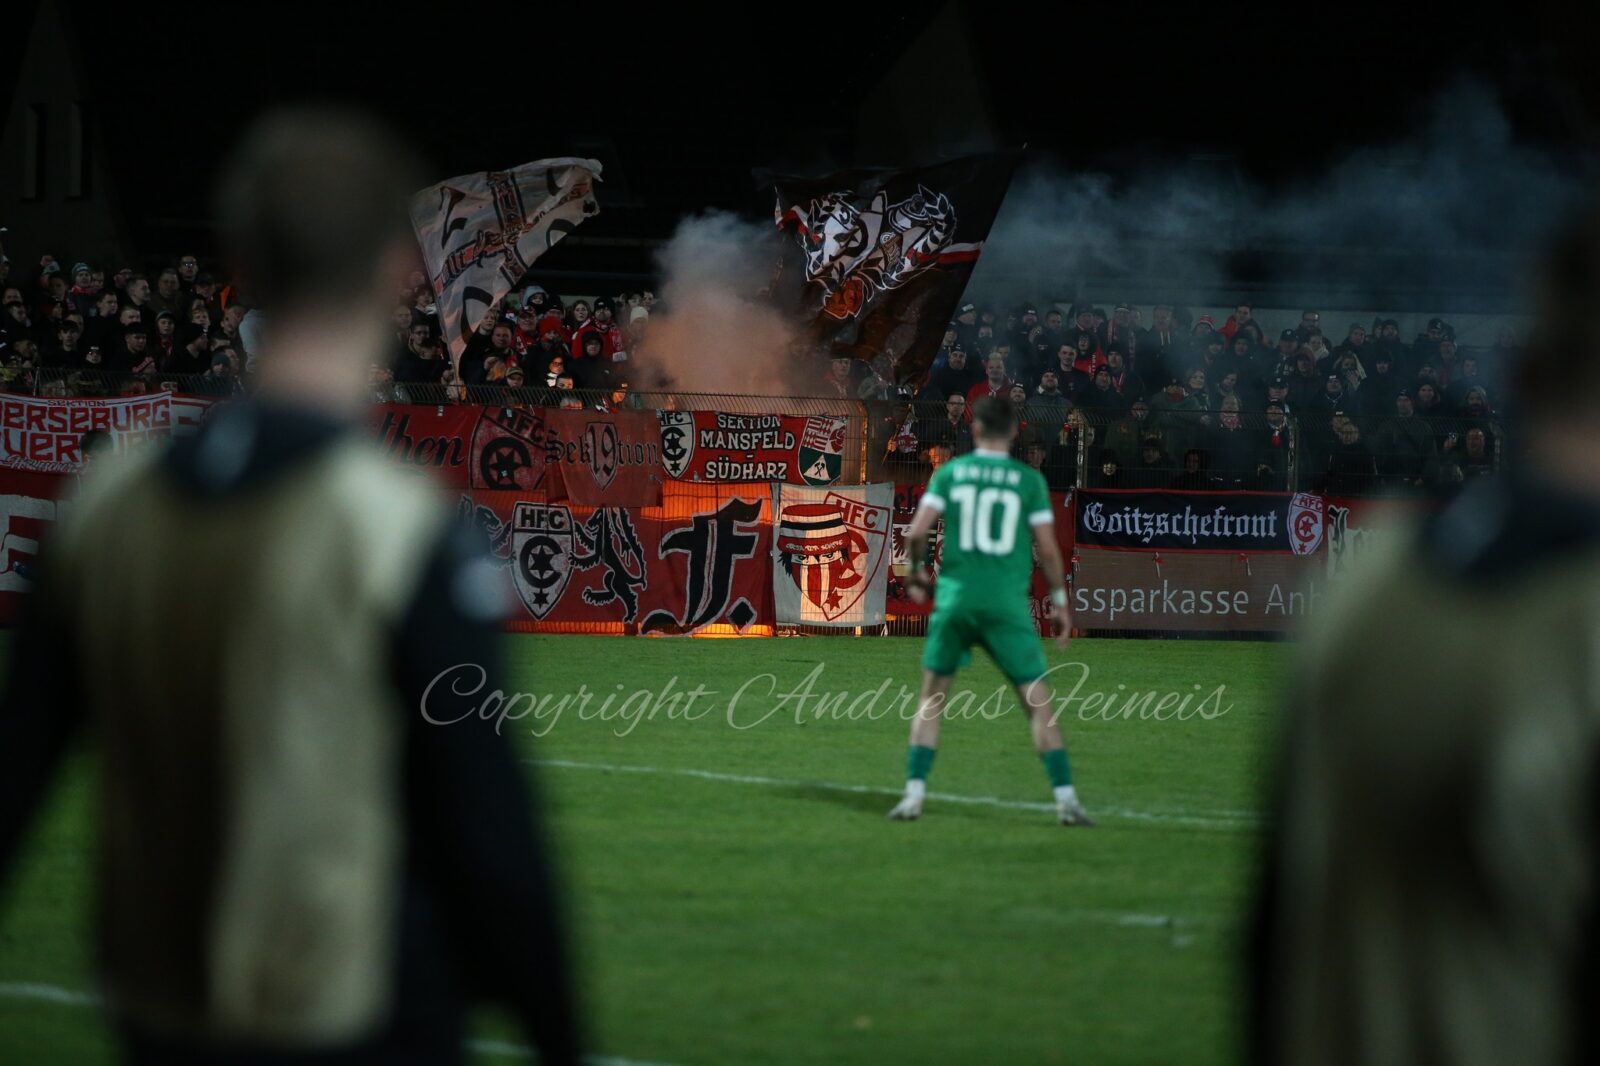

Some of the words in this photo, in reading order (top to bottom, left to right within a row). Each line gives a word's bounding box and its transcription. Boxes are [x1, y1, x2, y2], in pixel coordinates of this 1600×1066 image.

[0, 400, 171, 434] ERSEBURG
[717, 413, 782, 429] SEKTION
[700, 430, 796, 450] MANSFELD
[705, 457, 788, 480] SÜDHARZ
[520, 508, 564, 529] HFC
[834, 500, 879, 529] HFC
[949, 485, 1021, 555] 10
